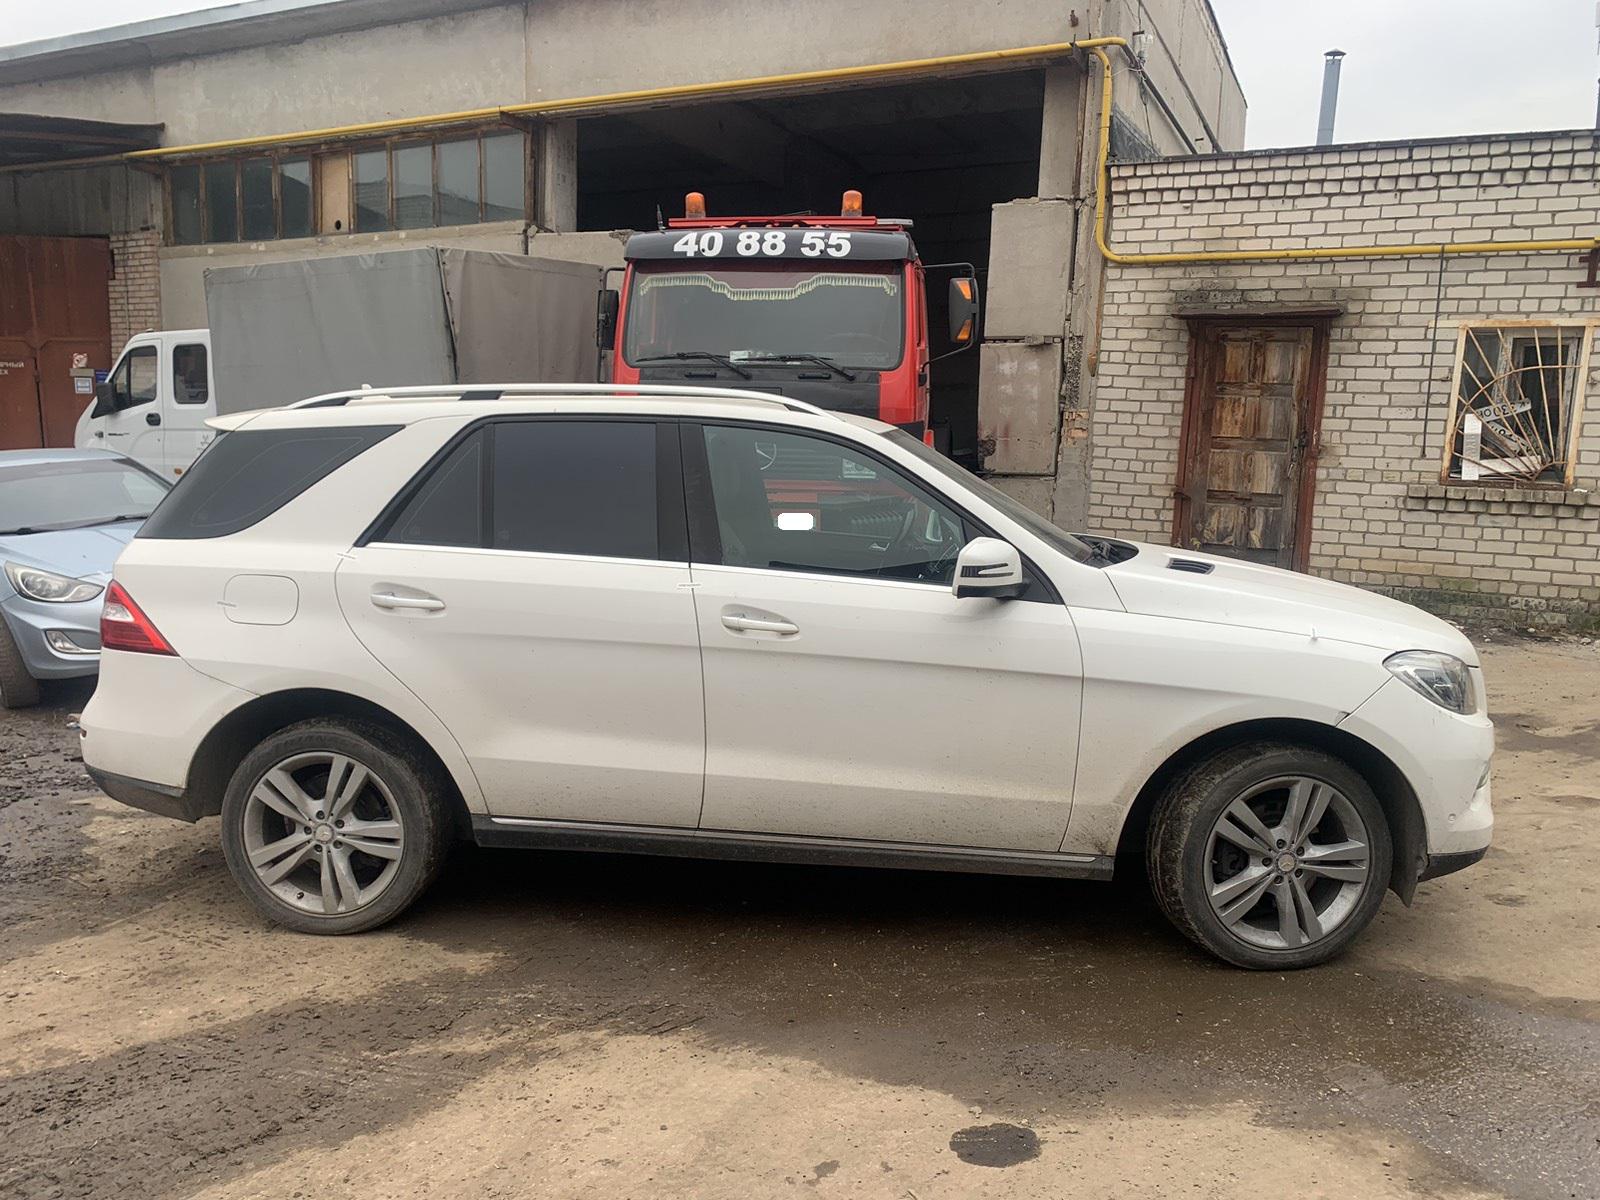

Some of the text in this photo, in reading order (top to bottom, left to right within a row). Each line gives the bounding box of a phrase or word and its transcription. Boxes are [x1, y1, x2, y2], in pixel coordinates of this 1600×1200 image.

[673, 231, 851, 257] 40 88 55
